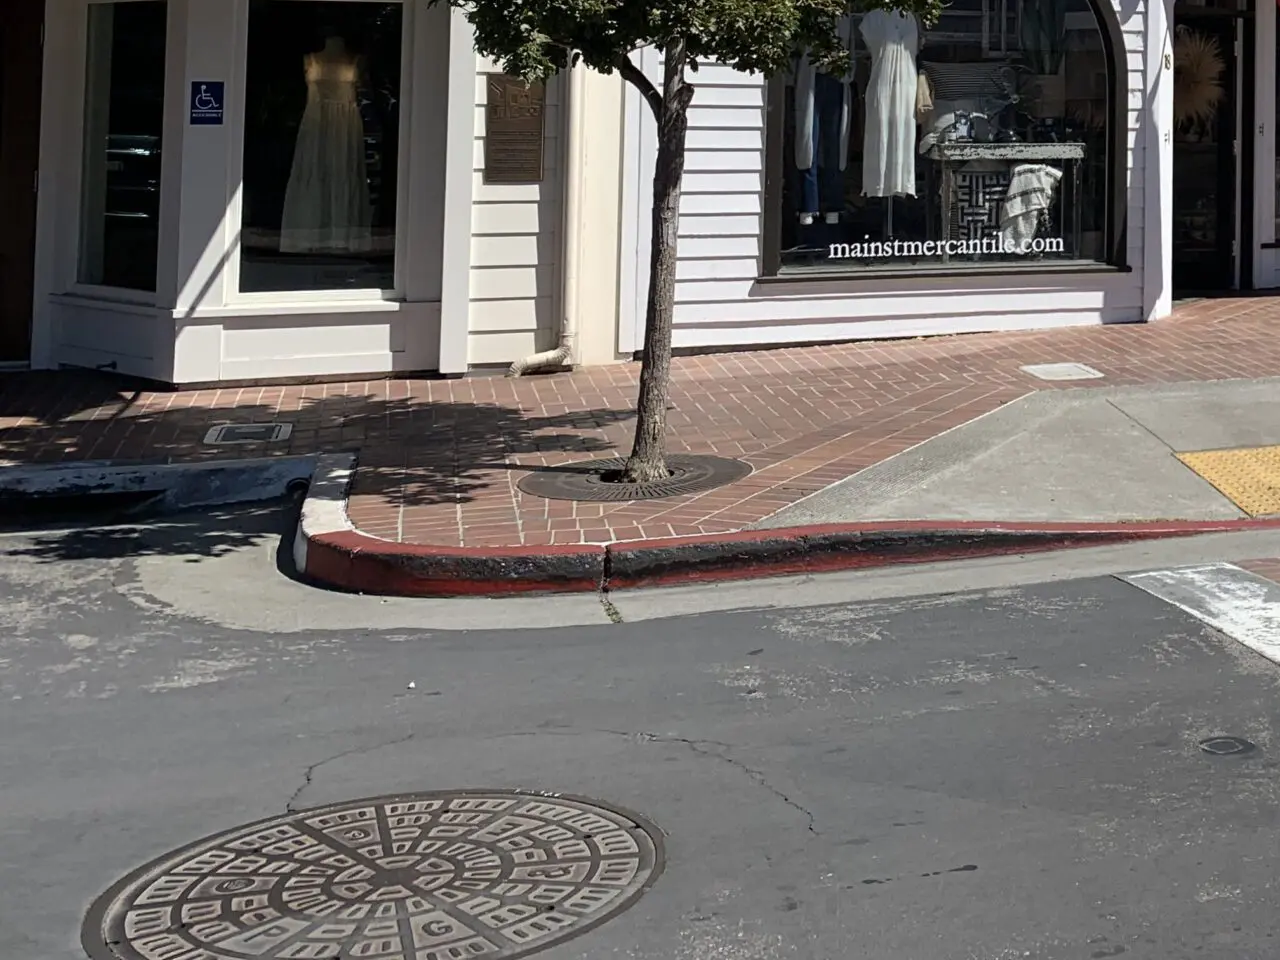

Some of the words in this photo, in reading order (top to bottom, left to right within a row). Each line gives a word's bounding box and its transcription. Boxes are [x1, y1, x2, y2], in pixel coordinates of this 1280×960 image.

[1164, 53, 1171, 71] 18
[828, 231, 1064, 258] mainstmercantile.com
[421, 920, 454, 937] G
